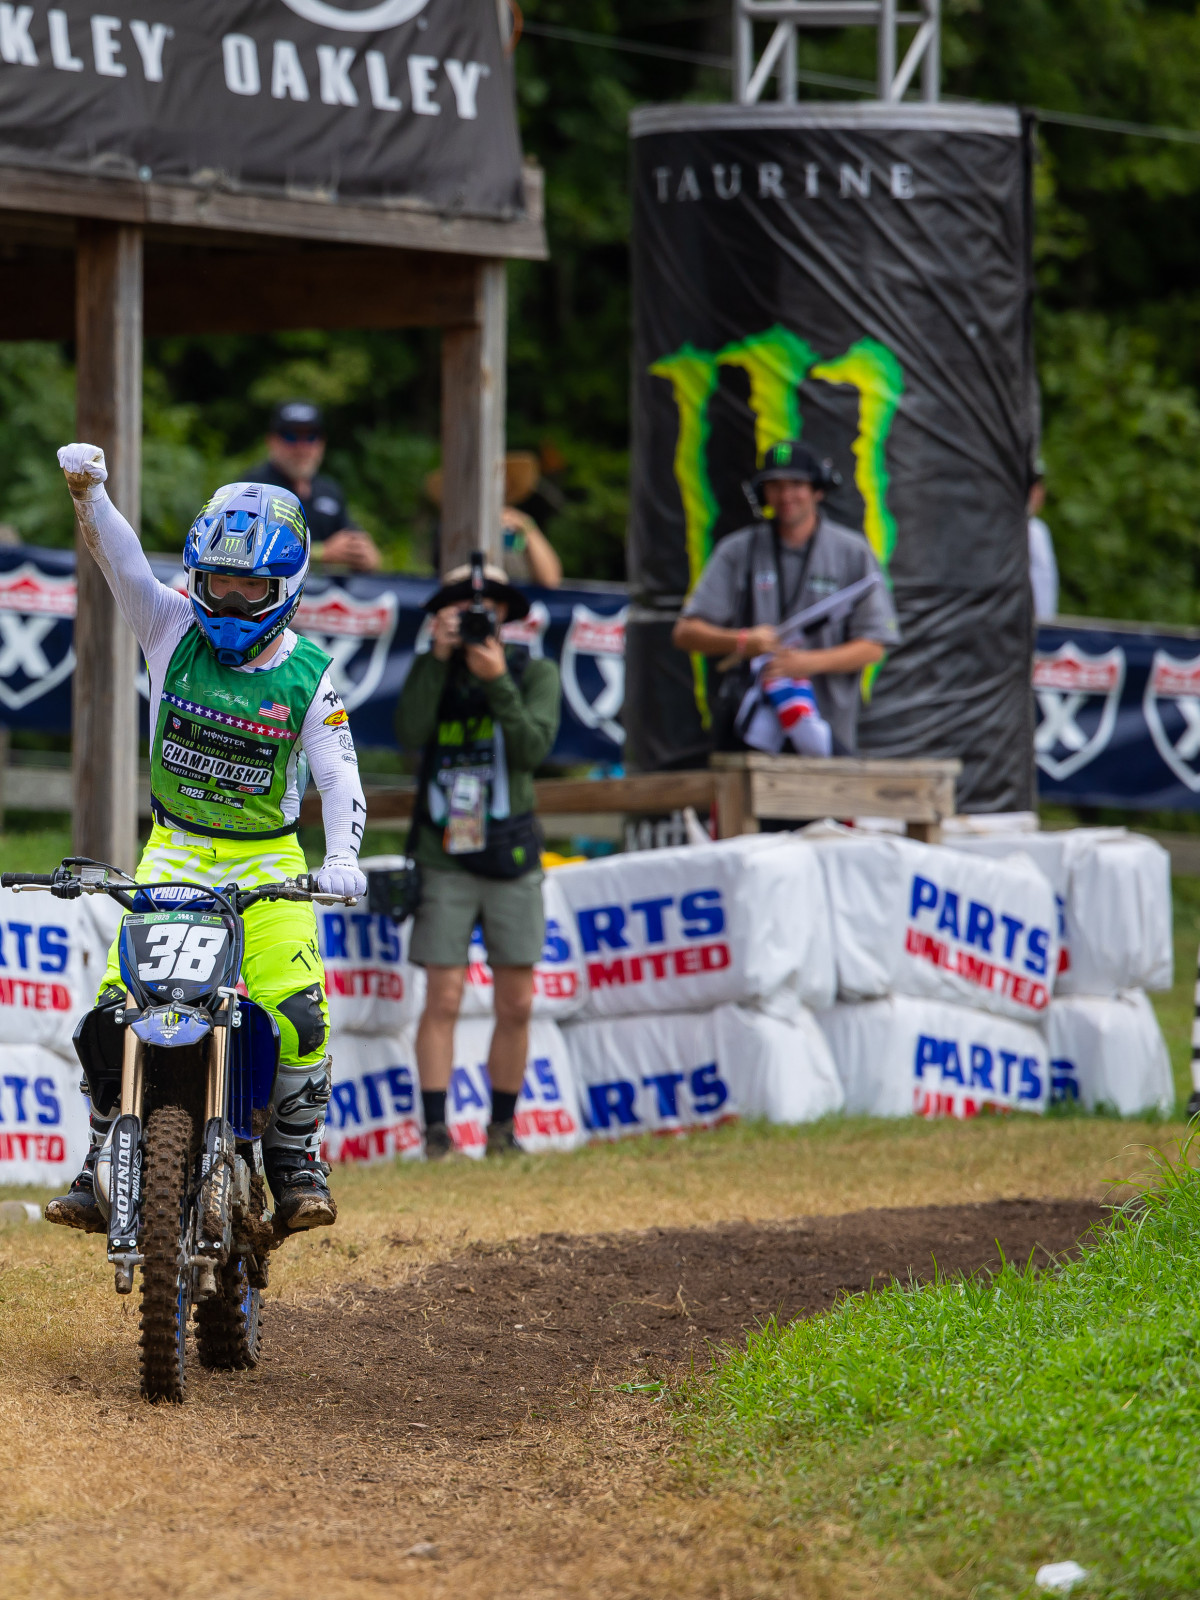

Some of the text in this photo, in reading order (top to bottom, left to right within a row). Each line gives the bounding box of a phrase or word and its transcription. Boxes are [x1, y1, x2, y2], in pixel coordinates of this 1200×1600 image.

[222, 34, 484, 120] OAKLEY
[653, 162, 915, 202] TAURINE
[203, 555, 251, 567] MONSTER
[196, 743, 228, 759] NATIONAL
[201, 729, 246, 748] MONSTER
[163, 743, 269, 784] CHAMPIONSHIP
[180, 785, 205, 799] 2025
[910, 873, 1051, 976] PARTS
[137, 923, 229, 983] 38
[905, 926, 1051, 1012] UNLIMITED
[914, 1034, 1043, 1100] PARTS
[116, 1130, 132, 1229] DUNLOP
[131, 1166, 141, 1201] CYCRA
